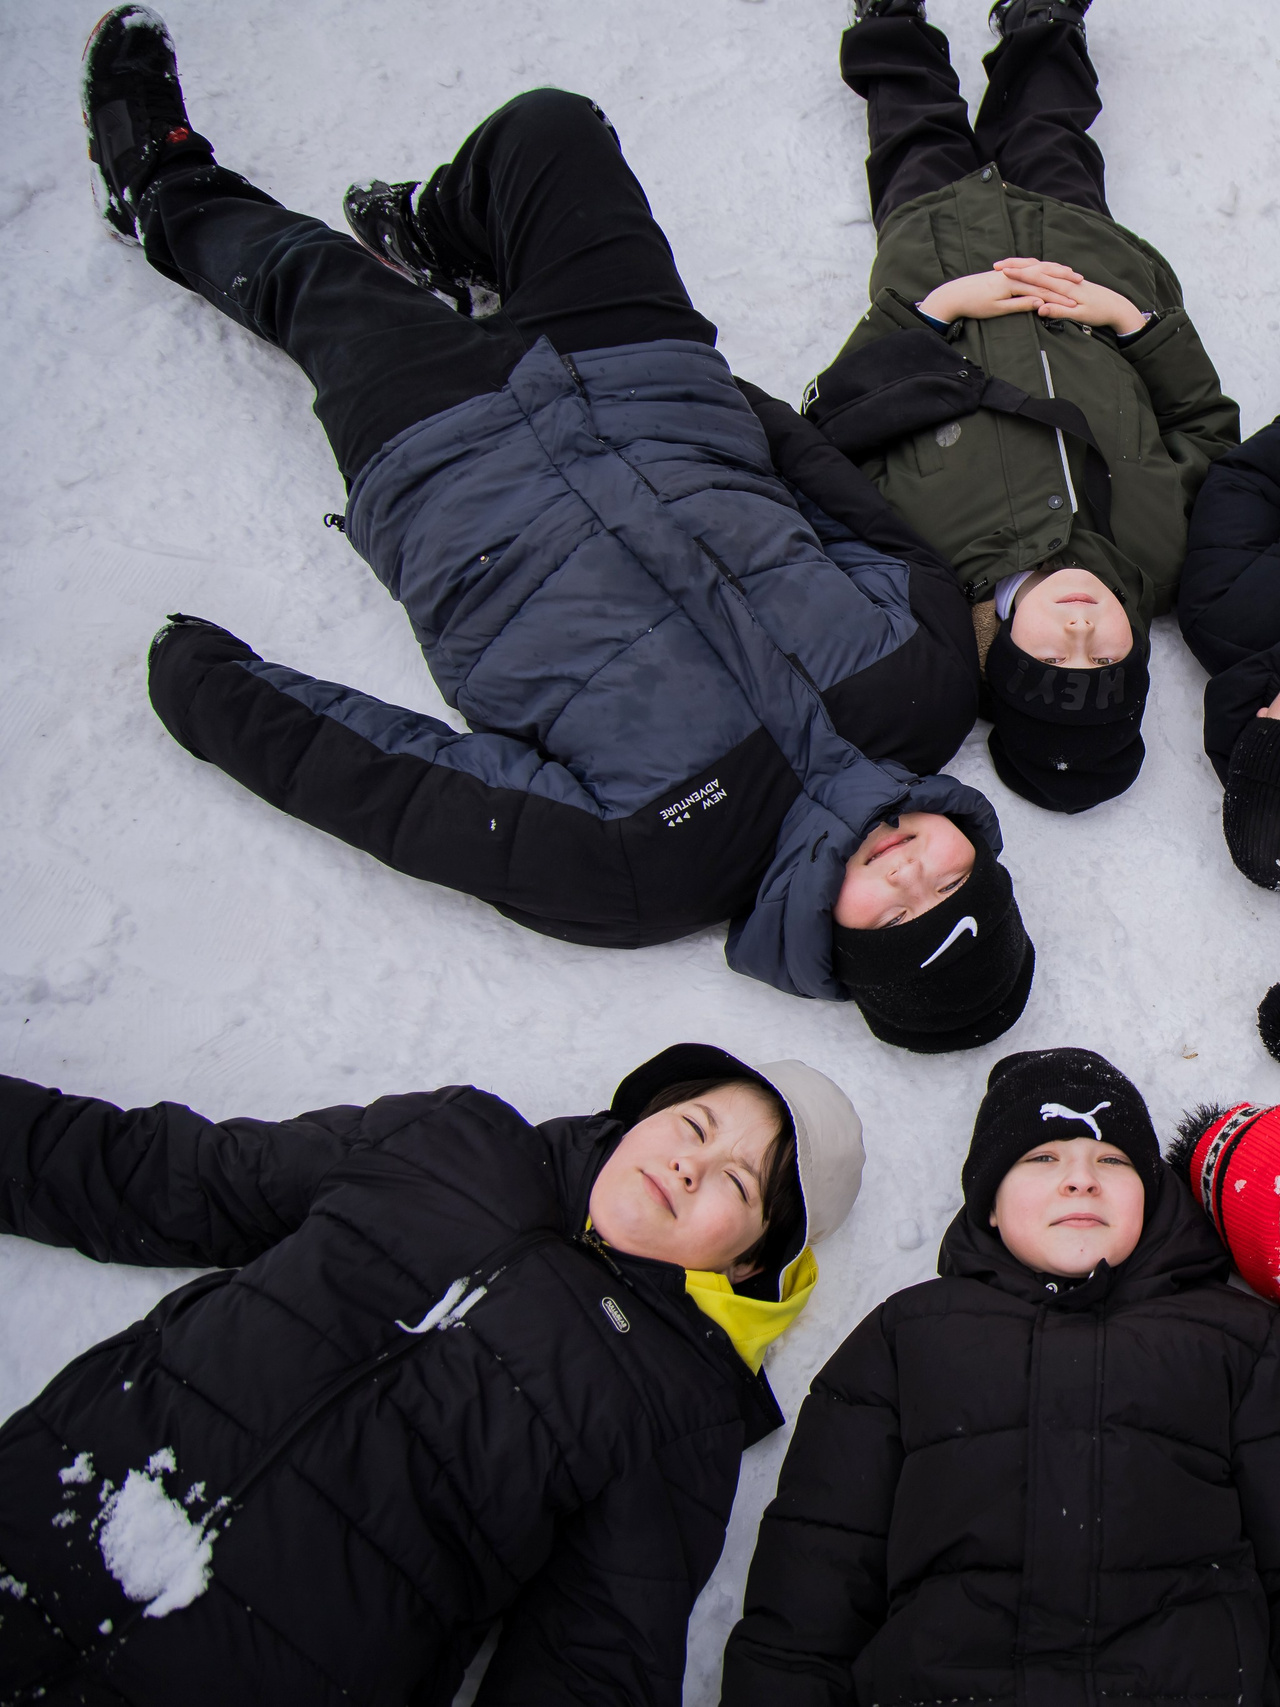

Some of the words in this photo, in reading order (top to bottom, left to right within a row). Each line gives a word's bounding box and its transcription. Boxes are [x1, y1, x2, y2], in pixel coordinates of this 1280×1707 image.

[1006, 659, 1125, 710] HEY!
[659, 778, 720, 820] ADVENTURE
[701, 788, 728, 810] NEW
